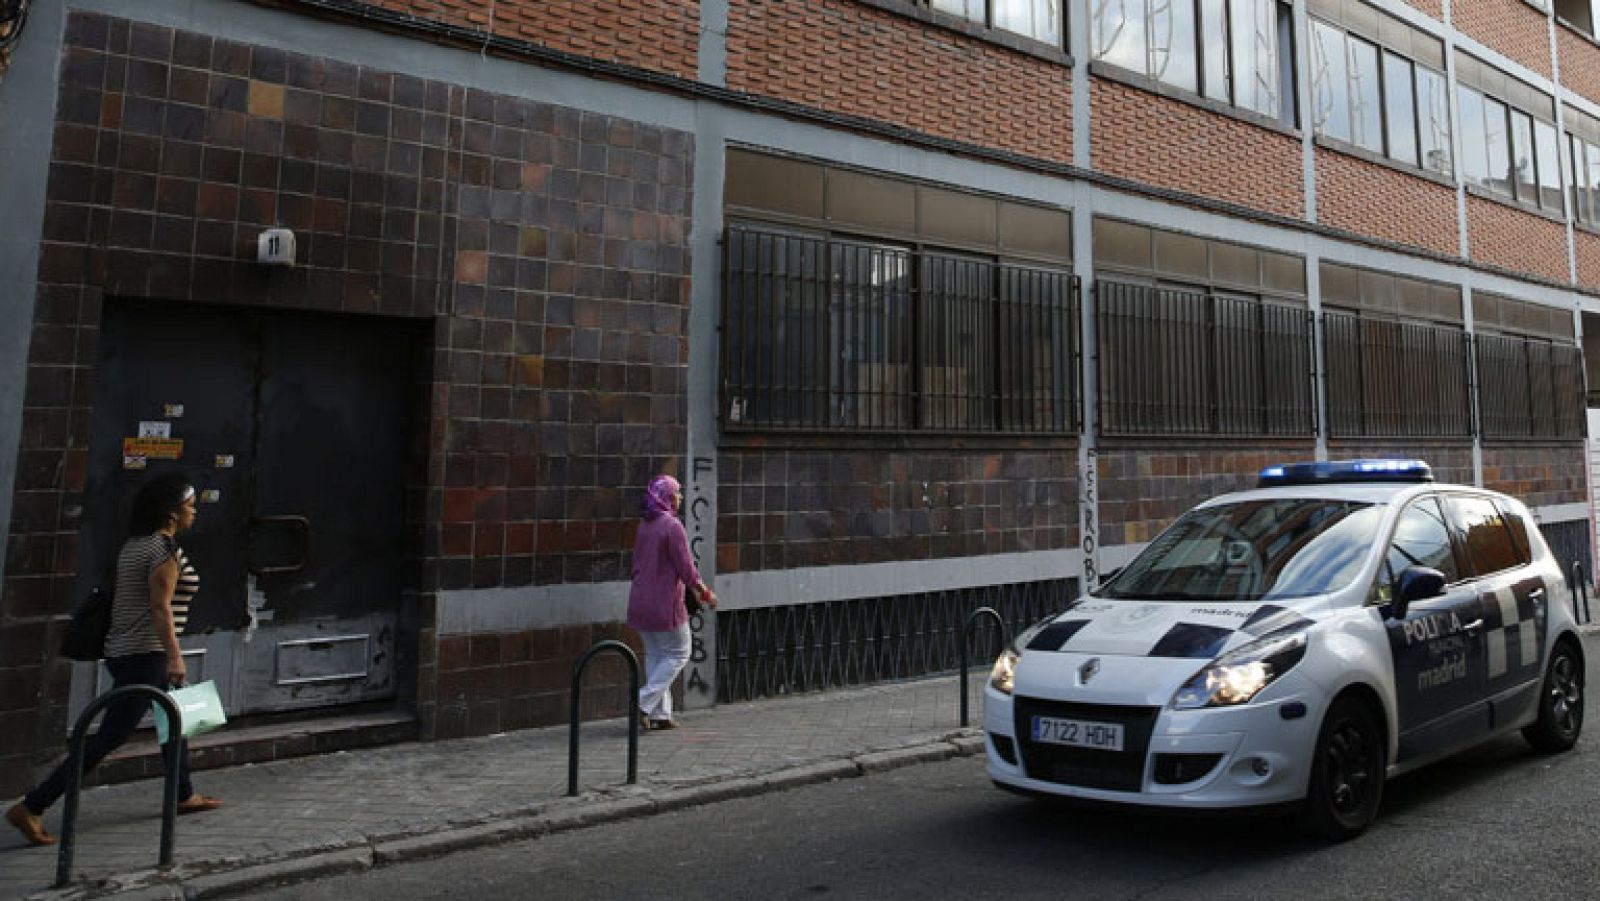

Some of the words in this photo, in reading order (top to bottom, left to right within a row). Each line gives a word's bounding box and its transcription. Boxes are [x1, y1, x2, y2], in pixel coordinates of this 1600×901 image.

[269, 235, 280, 256] 11
[1403, 609, 1463, 645] POLIIA
[688, 606, 708, 693] OBA
[1417, 651, 1466, 690] madrid
[1040, 719, 1078, 743] 7122
[1084, 725, 1117, 747] HDH
